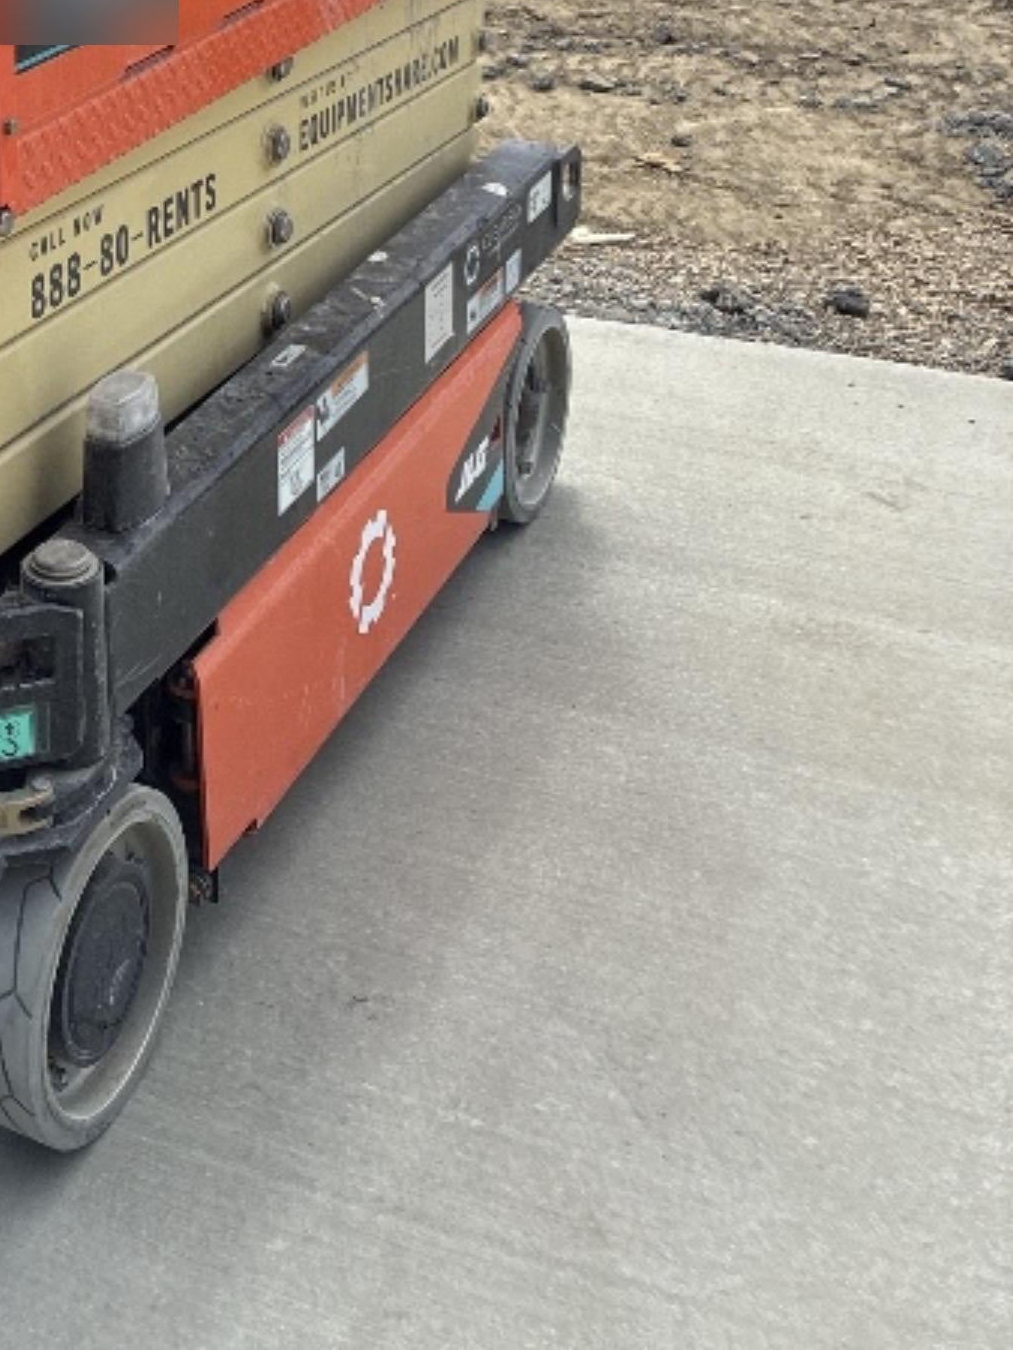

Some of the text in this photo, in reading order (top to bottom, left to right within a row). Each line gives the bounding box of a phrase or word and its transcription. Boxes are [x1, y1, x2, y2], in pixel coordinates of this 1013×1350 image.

[29, 204, 104, 262] CALL NOW
[31, 173, 217, 319] 888-80-RENTS
